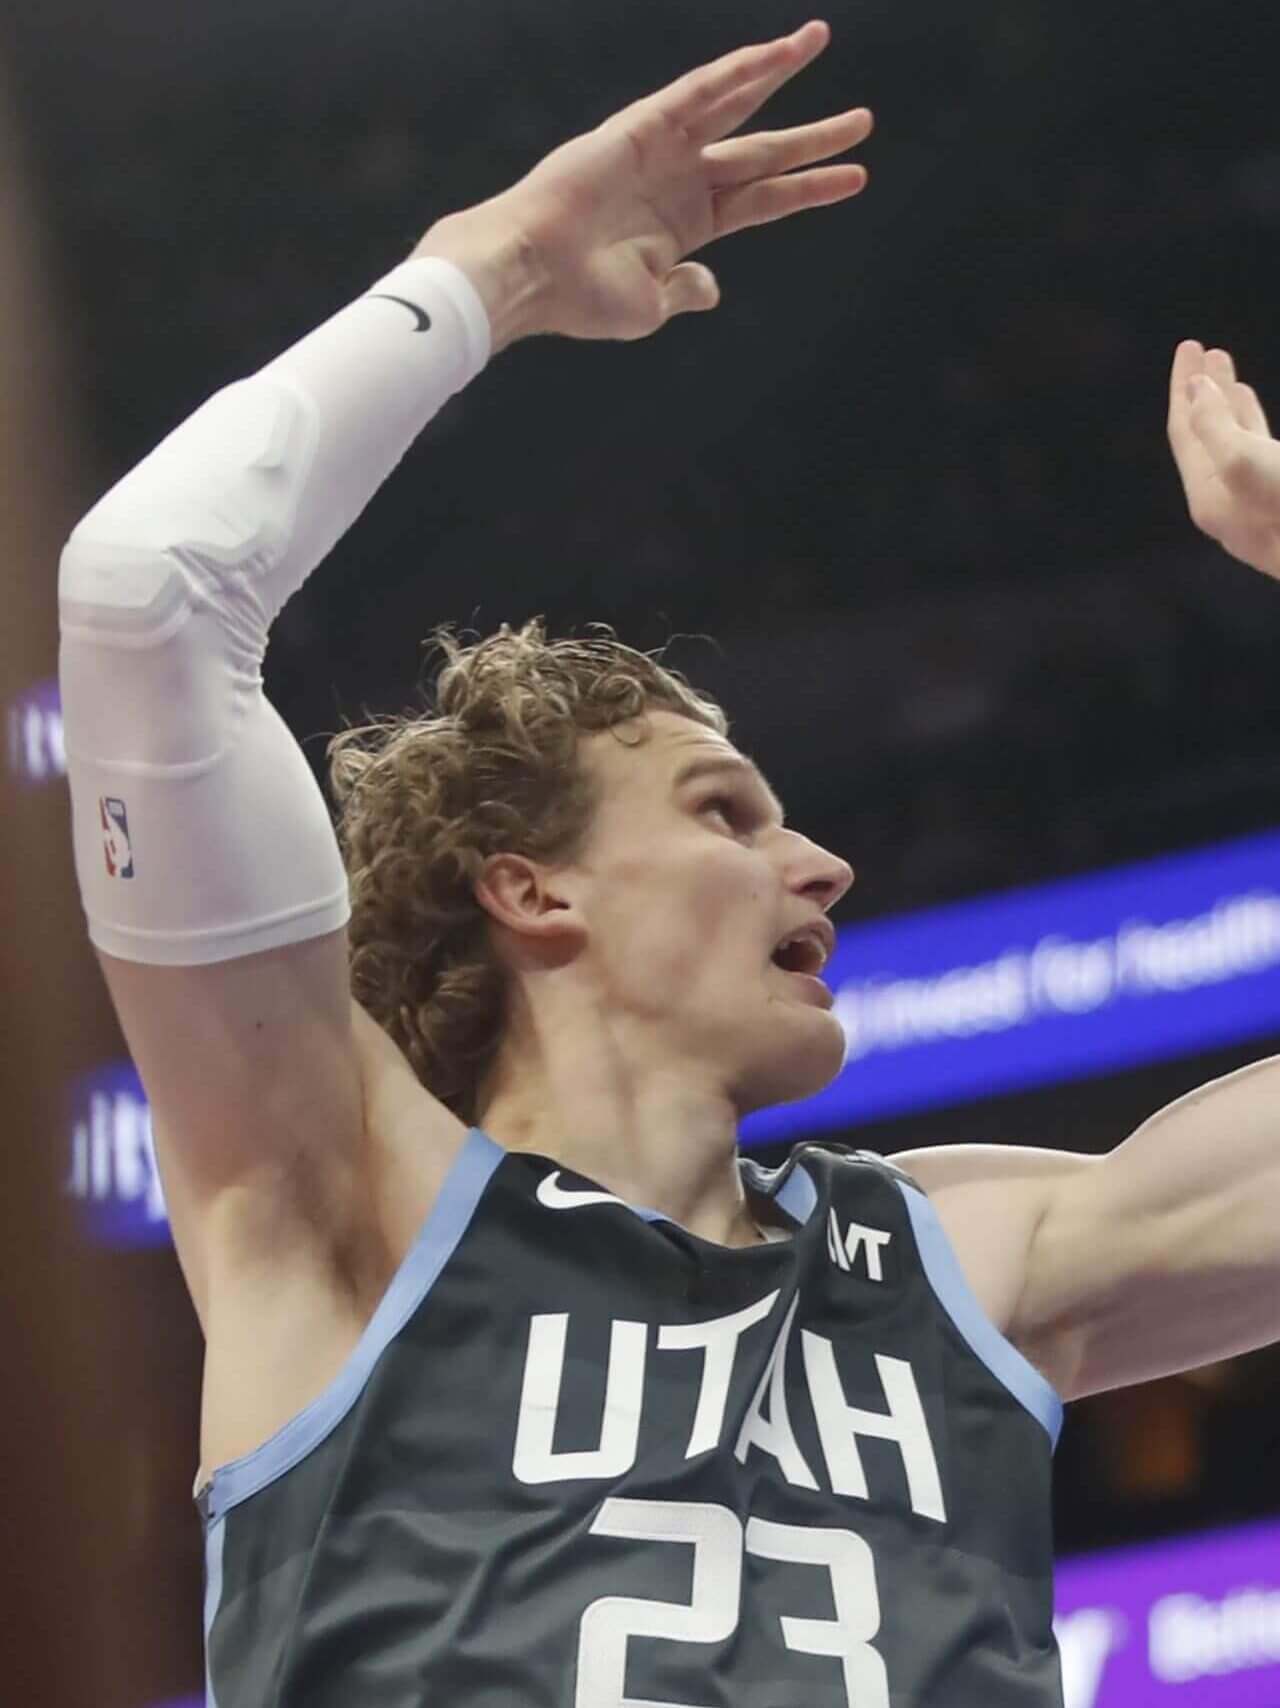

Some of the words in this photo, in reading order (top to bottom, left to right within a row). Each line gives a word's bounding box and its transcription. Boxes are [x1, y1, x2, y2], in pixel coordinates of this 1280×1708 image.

[1031, 933, 1116, 1015] for
[512, 1287, 947, 1523] UTAH
[575, 1497, 891, 1708] 23
